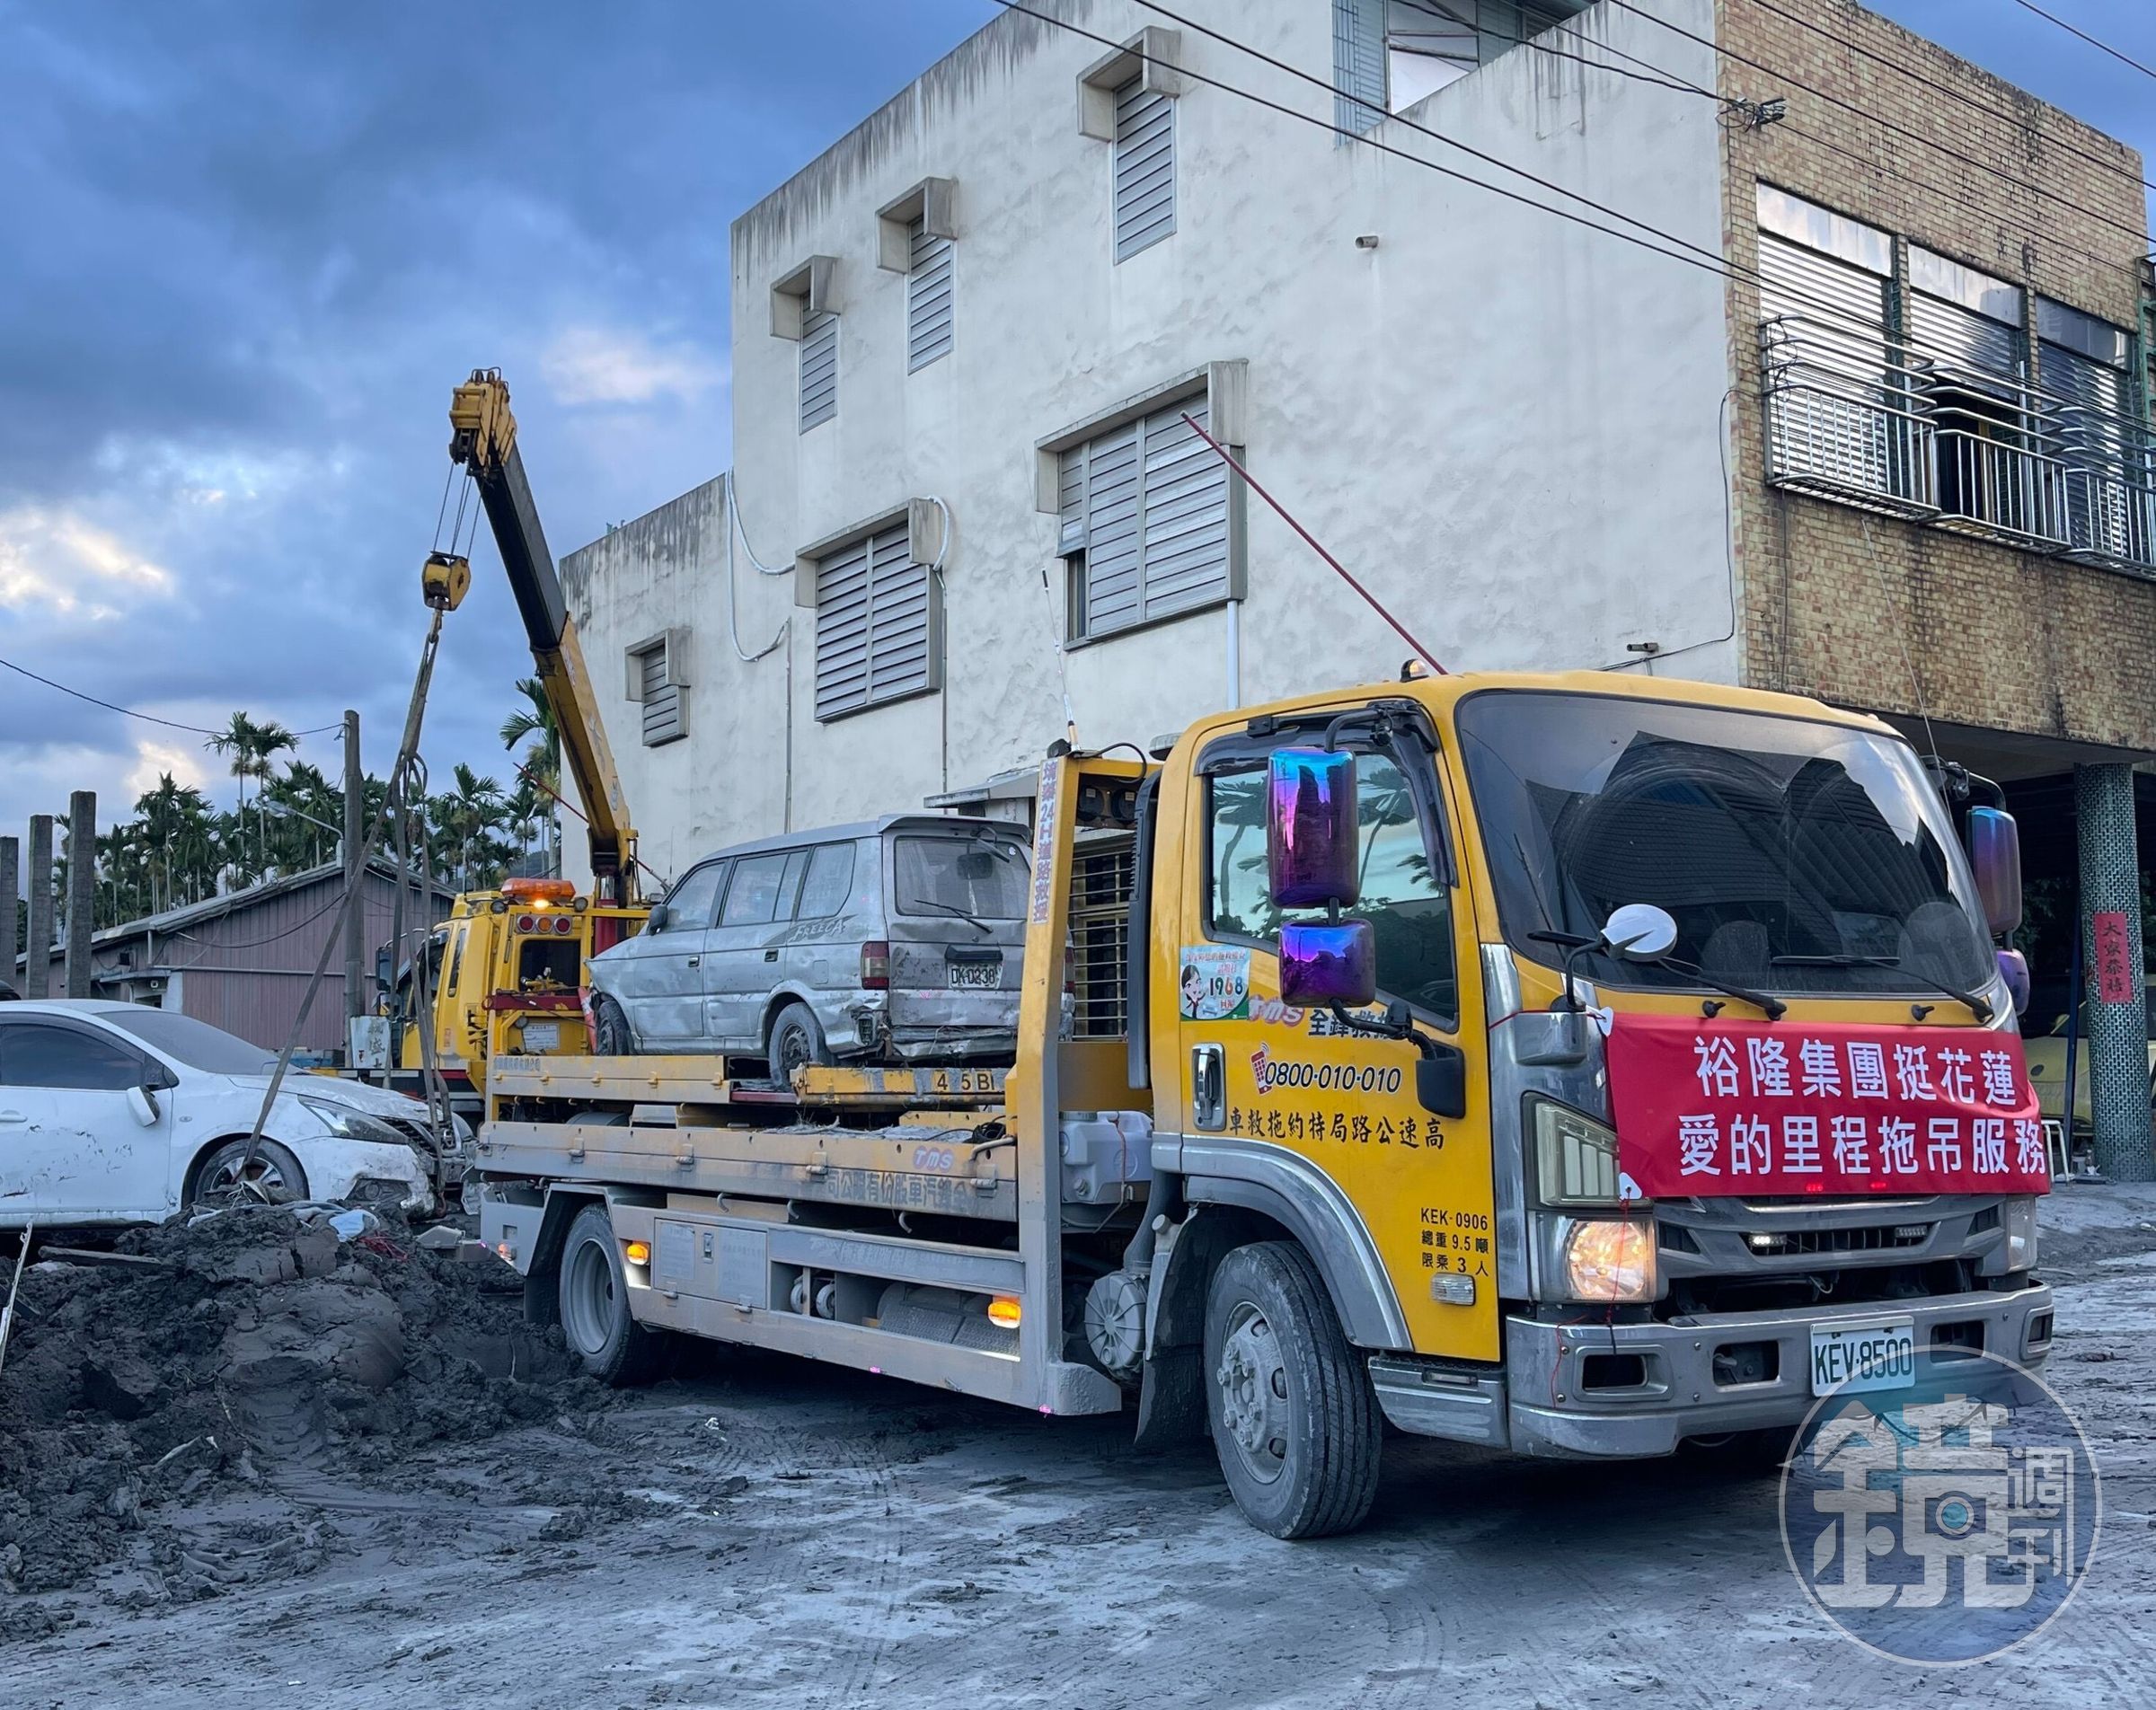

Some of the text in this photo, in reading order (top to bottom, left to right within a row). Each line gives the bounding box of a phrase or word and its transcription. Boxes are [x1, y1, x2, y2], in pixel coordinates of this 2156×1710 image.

[791, 920, 845, 940] FREECA
[1209, 976, 1243, 996] 1968
[1249, 996, 1303, 1027] TMS
[1693, 1035, 2017, 1106] 裕隆集團挺花蓮
[1678, 1113, 2046, 1177] 愛的里程拖吊服務
[914, 1146, 955, 1171] TMS
[1420, 1207, 1489, 1230] KEK-0906
[1452, 1234, 1471, 1251] 9.5
[1422, 1252, 1489, 1277] 限乘 3 人
[1813, 1336, 1913, 1386] KEV-8500
